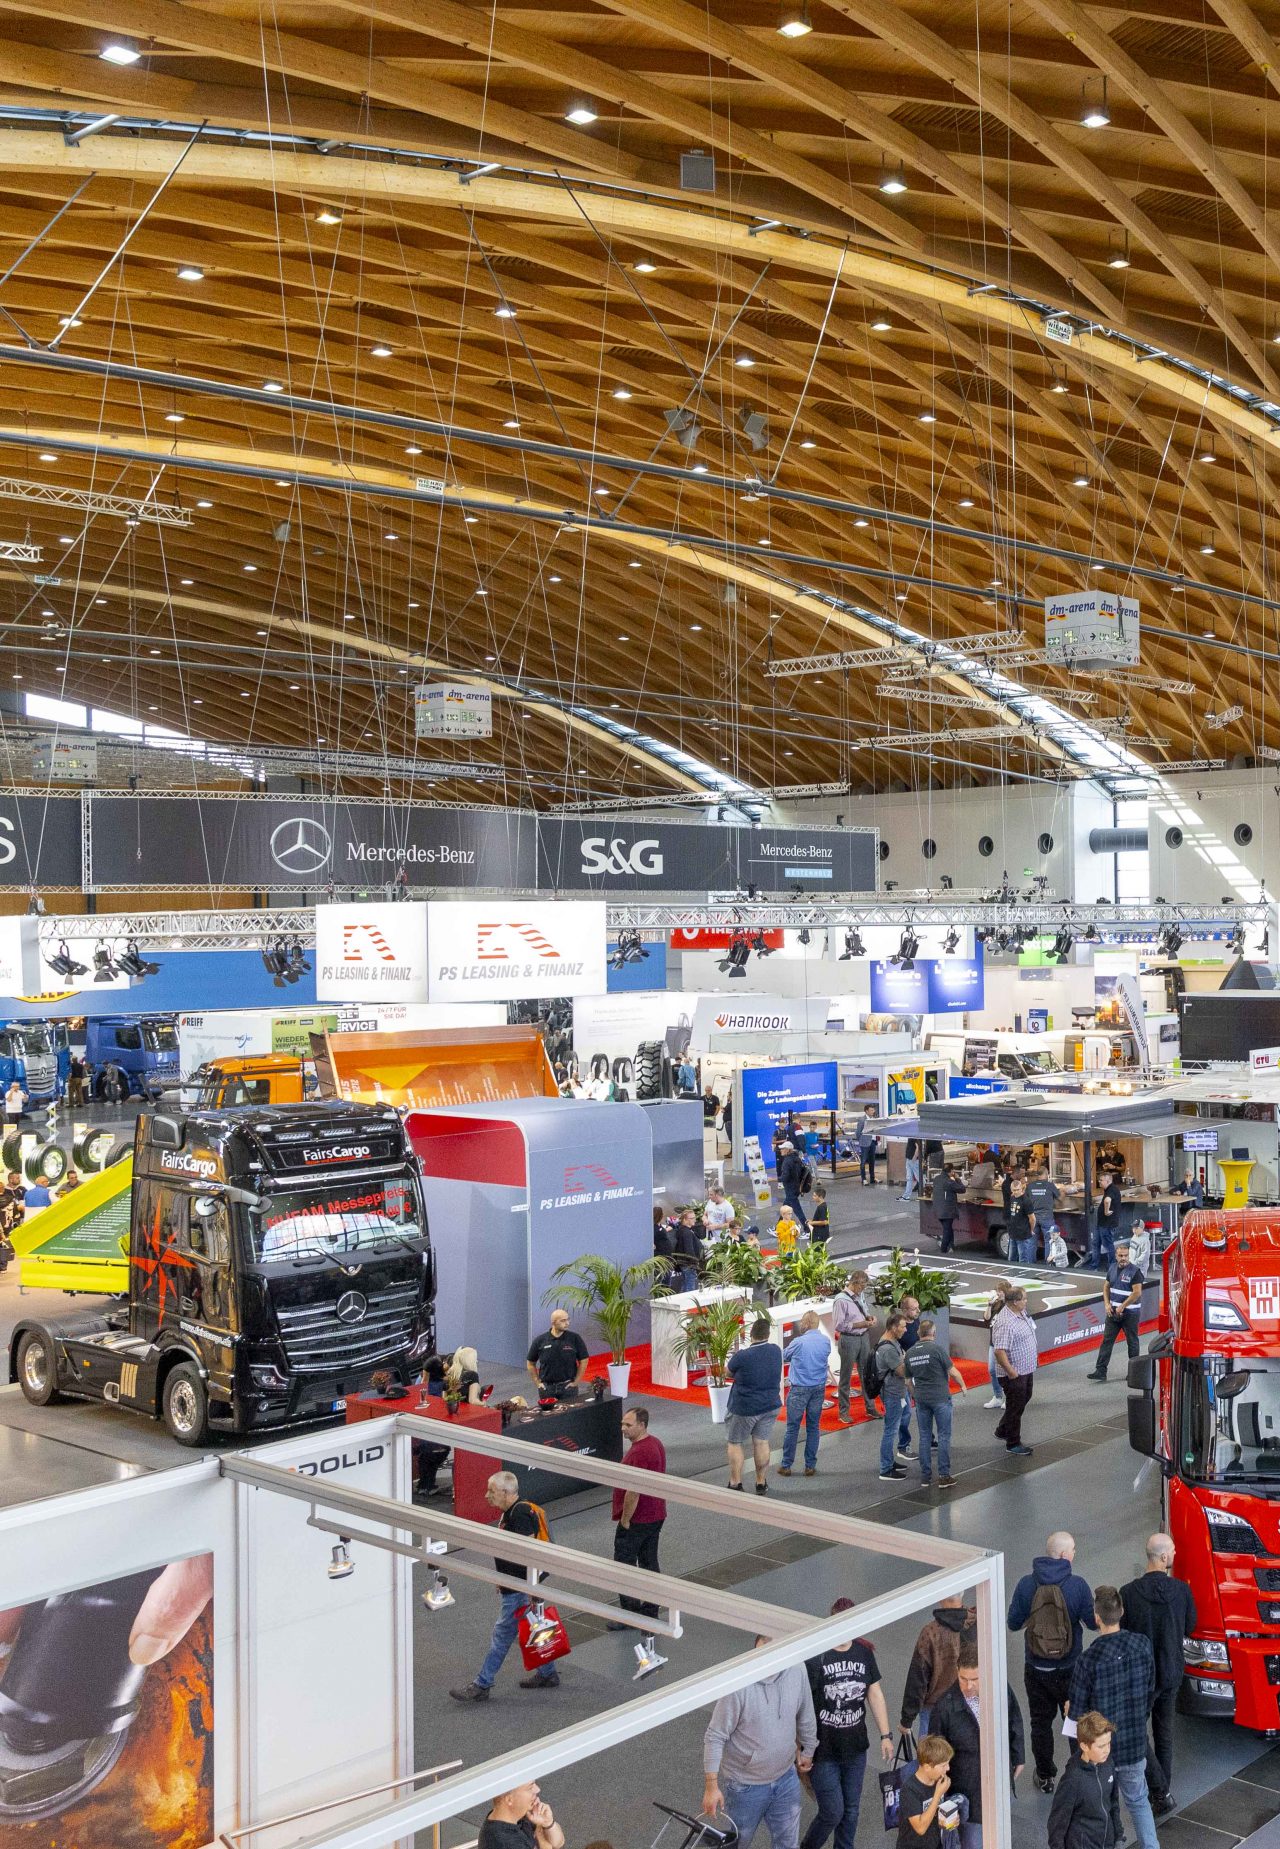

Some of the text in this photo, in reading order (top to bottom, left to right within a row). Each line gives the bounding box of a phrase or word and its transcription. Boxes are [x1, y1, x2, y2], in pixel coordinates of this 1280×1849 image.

[1049, 601, 1096, 616] dm-arena
[448, 689, 490, 701] dm-arena
[55, 742, 96, 752] dm-arena
[346, 842, 475, 864] Mercedes-Benz
[580, 837, 664, 876] S&G
[760, 843, 833, 859] Mercedes-Benz
[322, 966, 411, 981] PS LEASING & FINANZ
[438, 962, 584, 981] PS LEASING & FINANZ
[186, 1017, 203, 1027] REIFF
[1256, 1055, 1269, 1065] GTÜ
[768, 1088, 791, 1097] Zukunft
[303, 1145, 370, 1162] FairsCargo
[161, 1150, 217, 1178] FairsCargo
[328, 1185, 410, 1214] Messepreis:
[540, 1199, 553, 1210] PS
[554, 1192, 592, 1208] LEASING
[593, 1191, 601, 1202] &
[602, 1186, 634, 1200] FINANZ
[1054, 1336, 1062, 1345] PS
